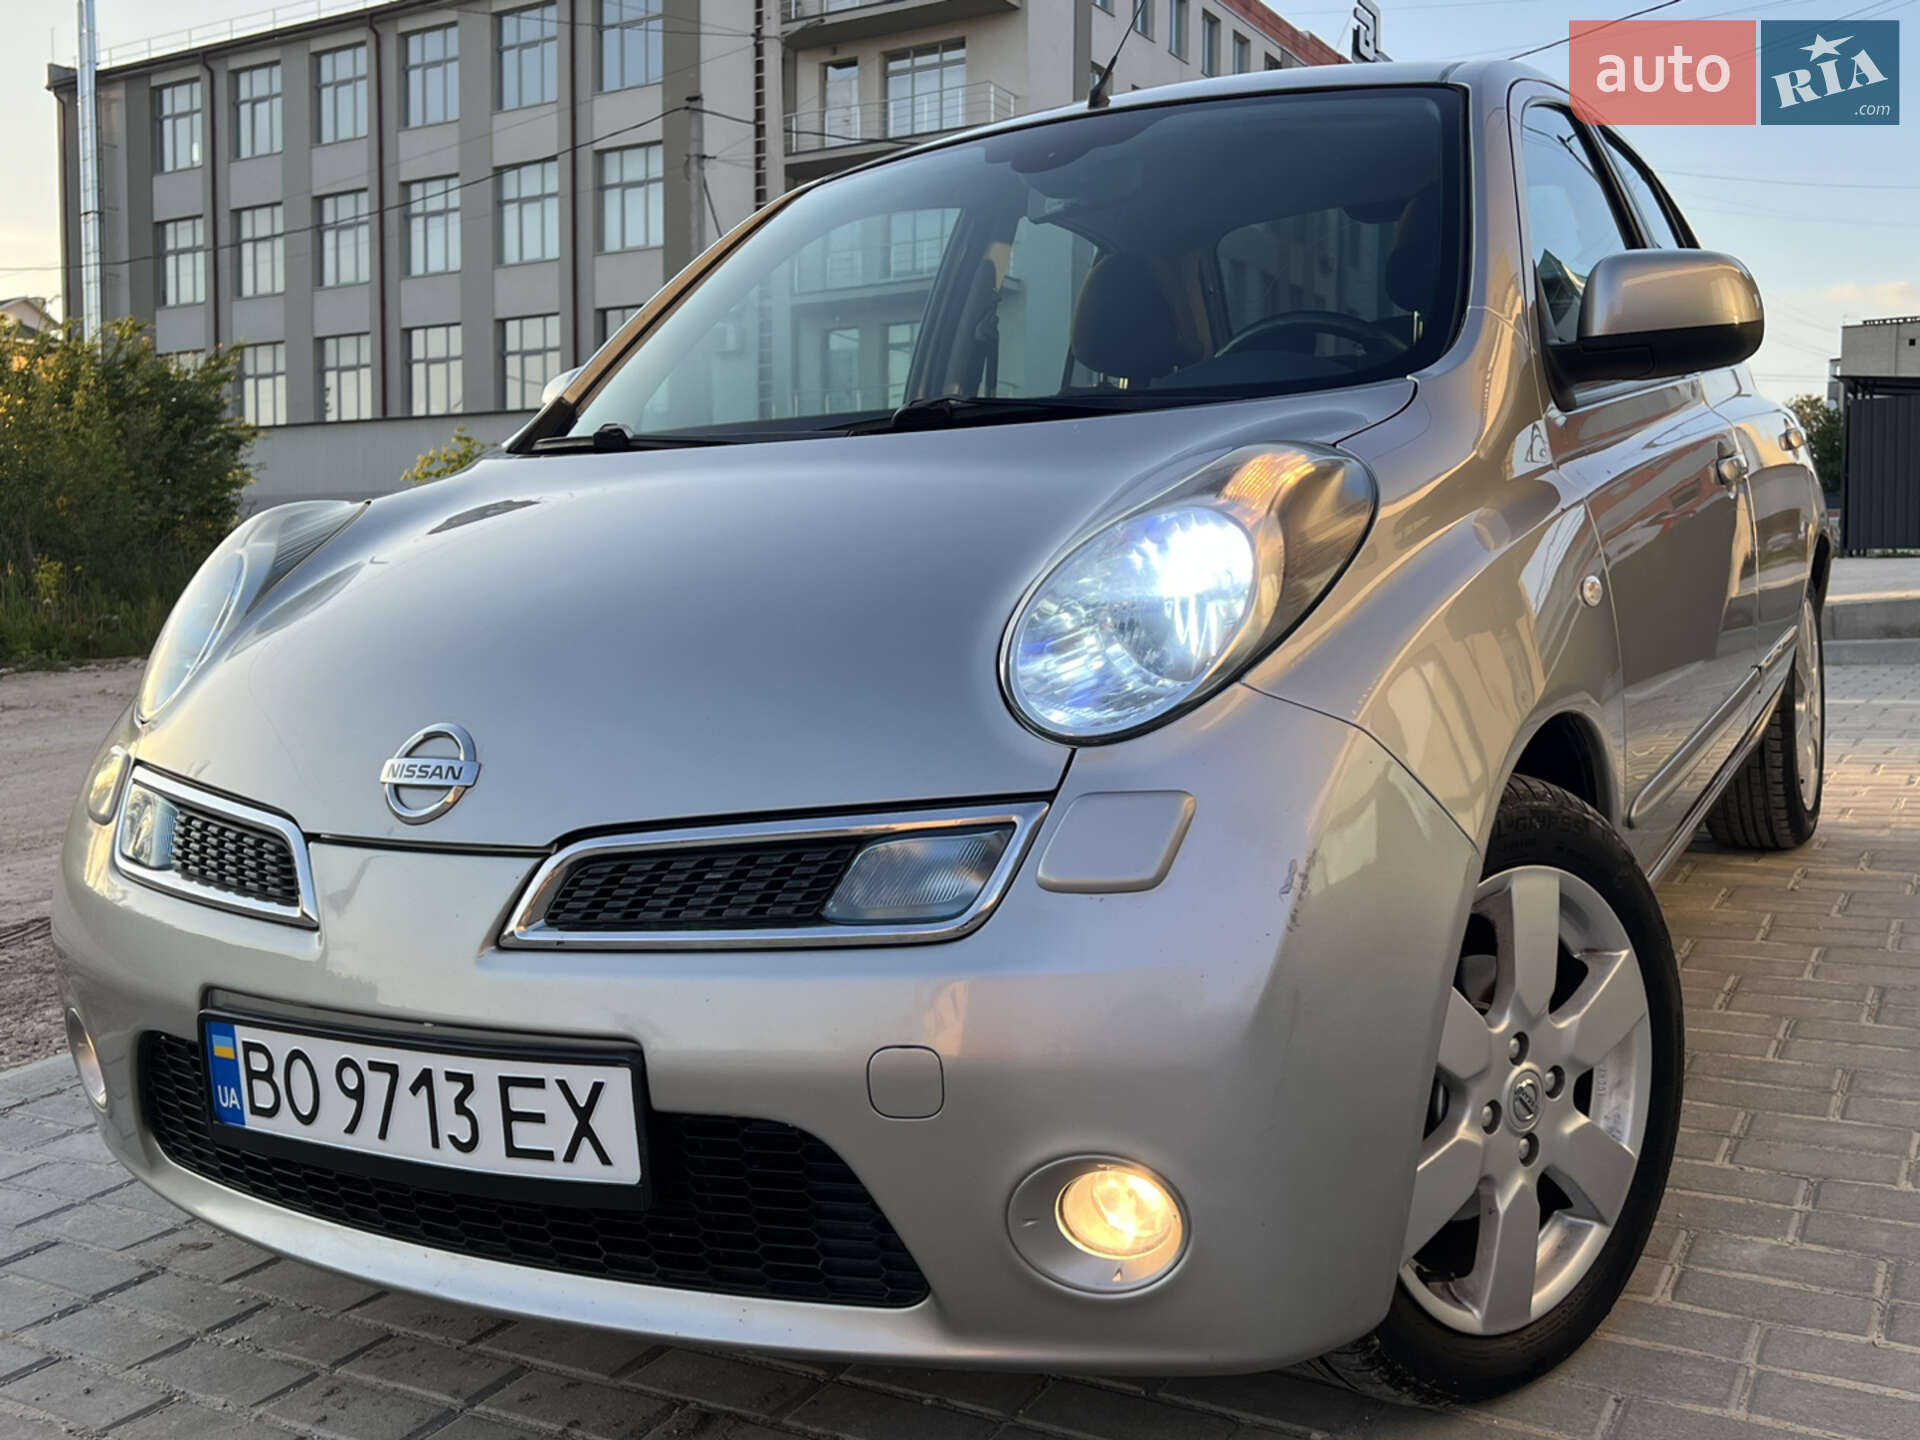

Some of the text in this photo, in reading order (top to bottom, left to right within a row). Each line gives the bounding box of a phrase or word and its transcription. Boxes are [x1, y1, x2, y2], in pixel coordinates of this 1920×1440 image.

[386, 763, 464, 781] NISSAN
[217, 1084, 241, 1110] UA
[241, 1040, 614, 1166] BO 9713 EX
